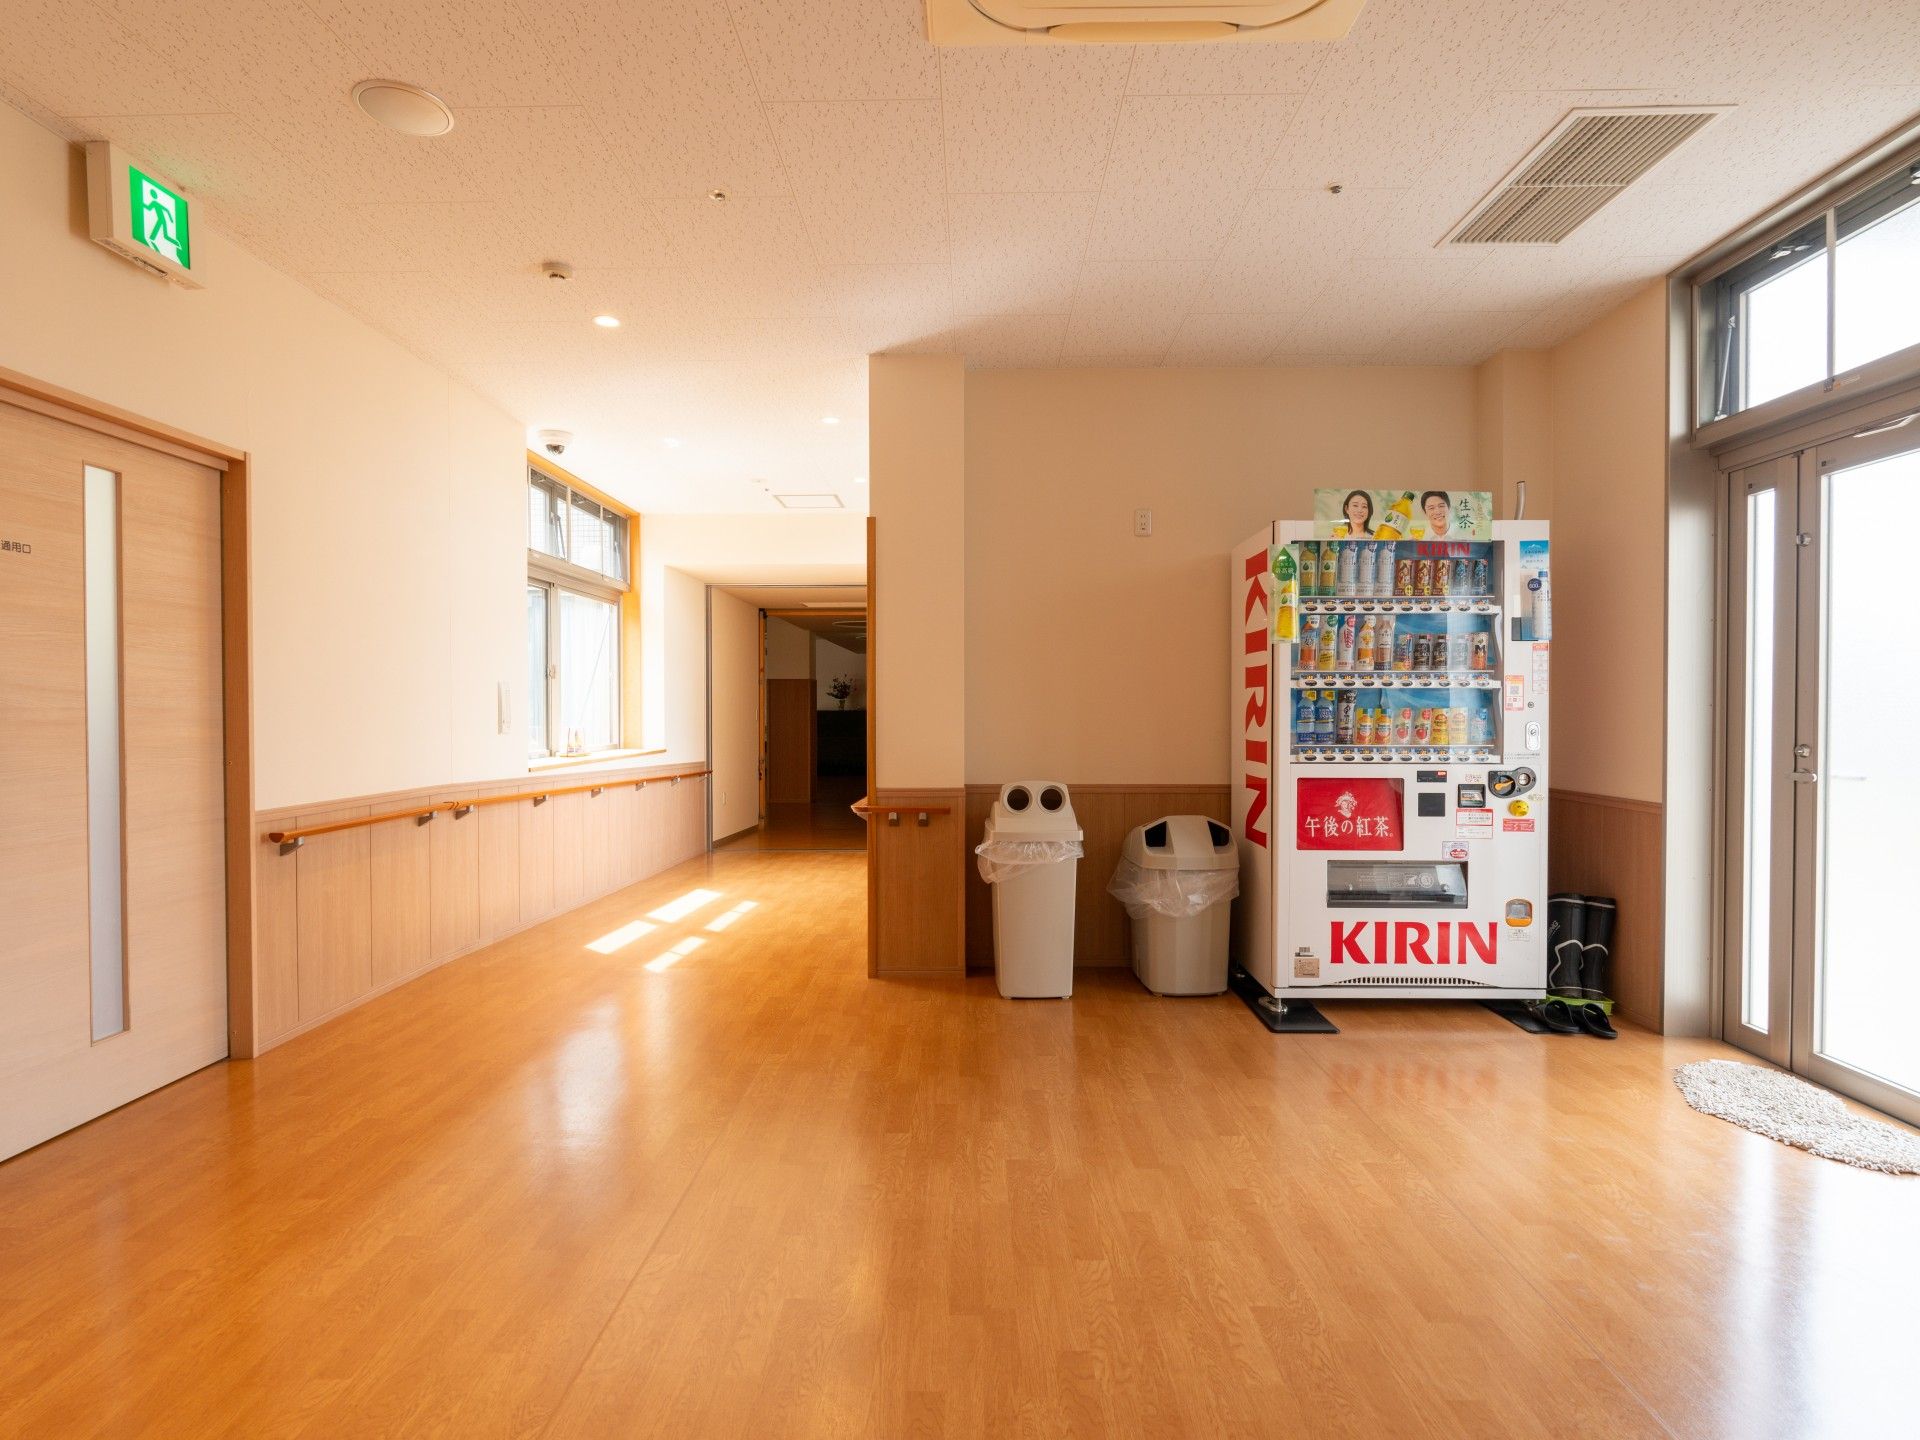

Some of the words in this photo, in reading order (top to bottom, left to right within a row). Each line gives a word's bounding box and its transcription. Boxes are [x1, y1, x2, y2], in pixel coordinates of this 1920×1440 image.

[1459, 498, 1474, 529] 生茶
[1417, 543, 1470, 557] KIRIN
[1245, 548, 1268, 849] KIRIN
[1305, 816, 1389, 837] 午後の紅茶
[1330, 921, 1498, 965] KIRIN
